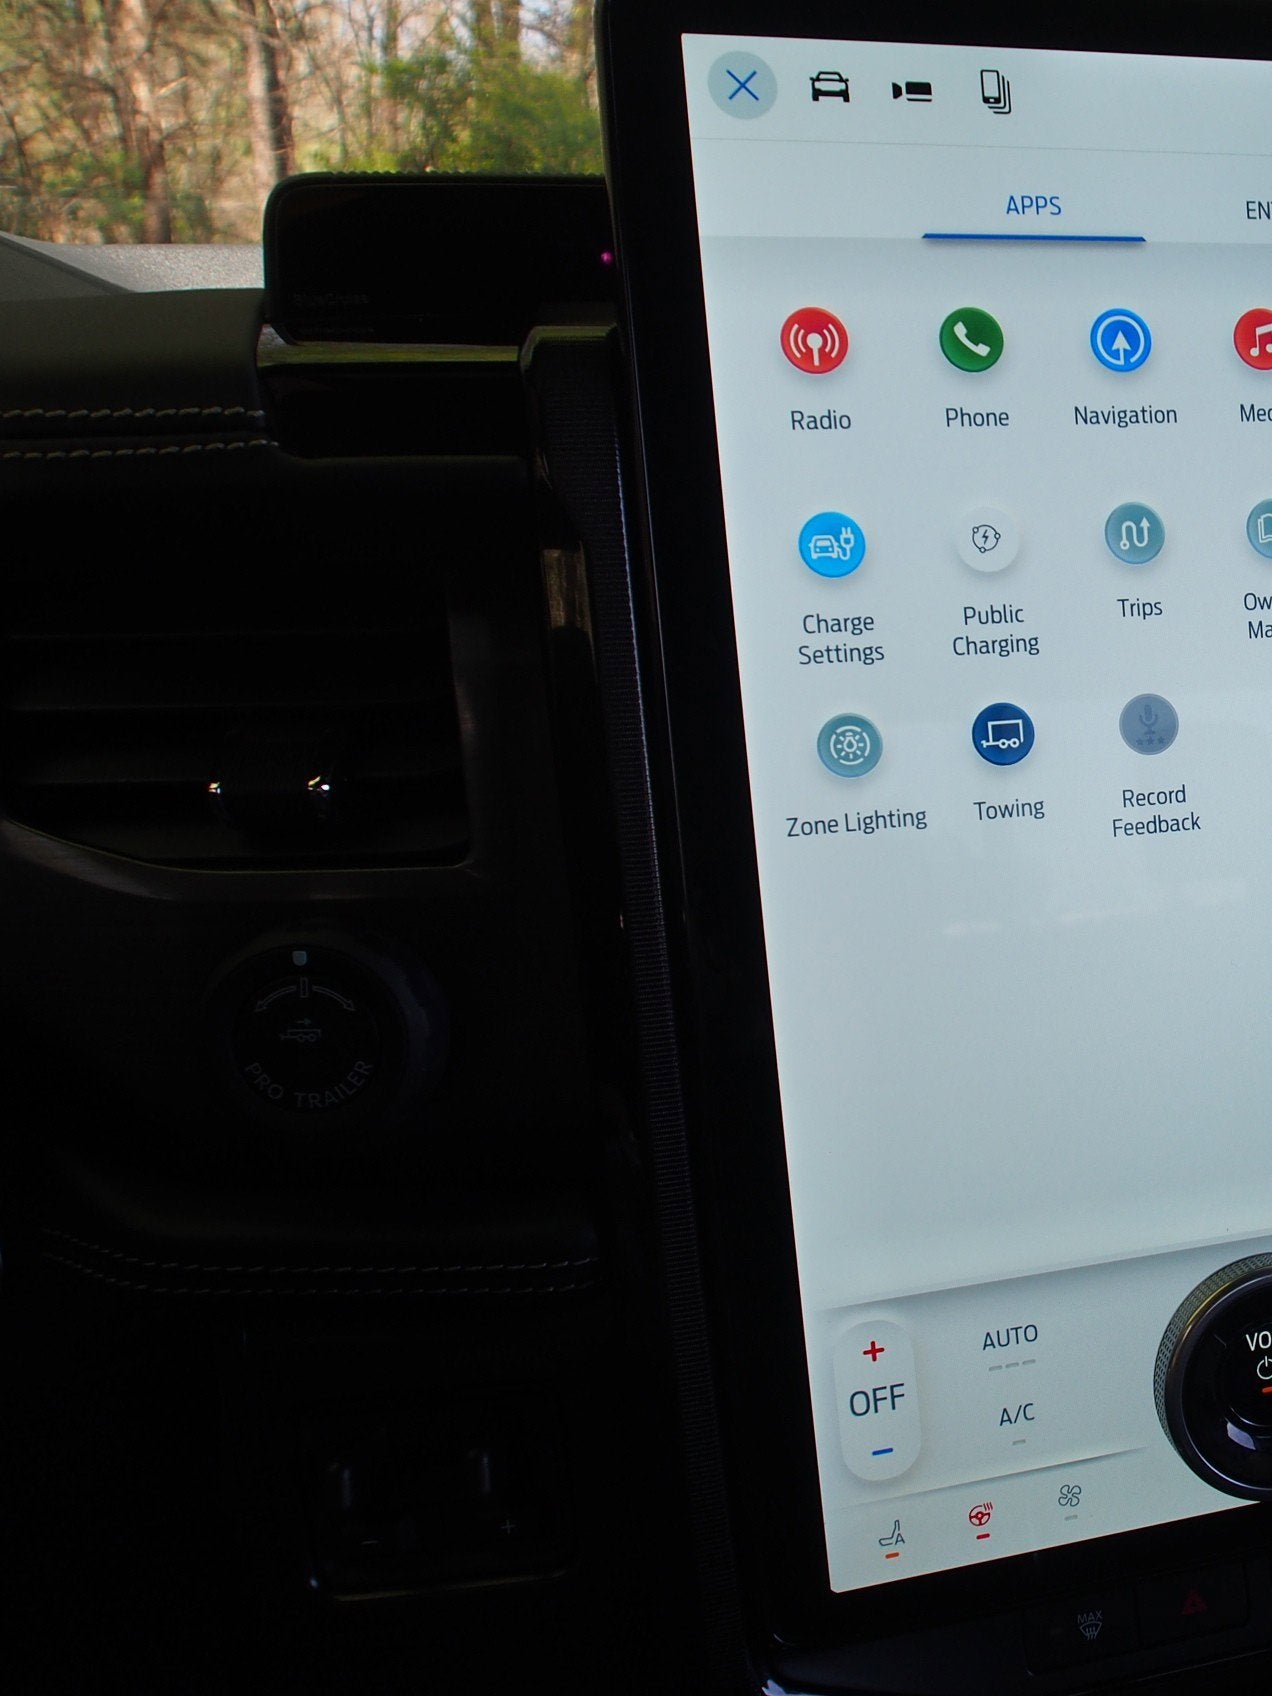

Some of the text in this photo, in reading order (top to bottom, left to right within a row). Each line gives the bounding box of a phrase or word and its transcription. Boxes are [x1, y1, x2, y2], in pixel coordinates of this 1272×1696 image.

[1006, 195, 1062, 216] APPS
[790, 408, 852, 431] Radio
[945, 406, 1010, 428] Phone
[1074, 404, 1178, 429] Navigation
[963, 603, 1025, 626] Public
[1116, 597, 1163, 621] Trips
[802, 613, 875, 636] Charge
[798, 643, 885, 666] Settings
[952, 633, 1040, 658] Charging
[1122, 783, 1187, 808] Record
[972, 798, 1045, 821] Towing
[785, 808, 928, 838] Zone Lighting
[1112, 811, 1202, 838] Feedback
[244, 1060, 375, 1109] PRO TRAILER
[982, 1324, 1038, 1351] AUTO
[849, 1382, 905, 1417] OFF
[999, 1402, 1035, 1427] A/C
